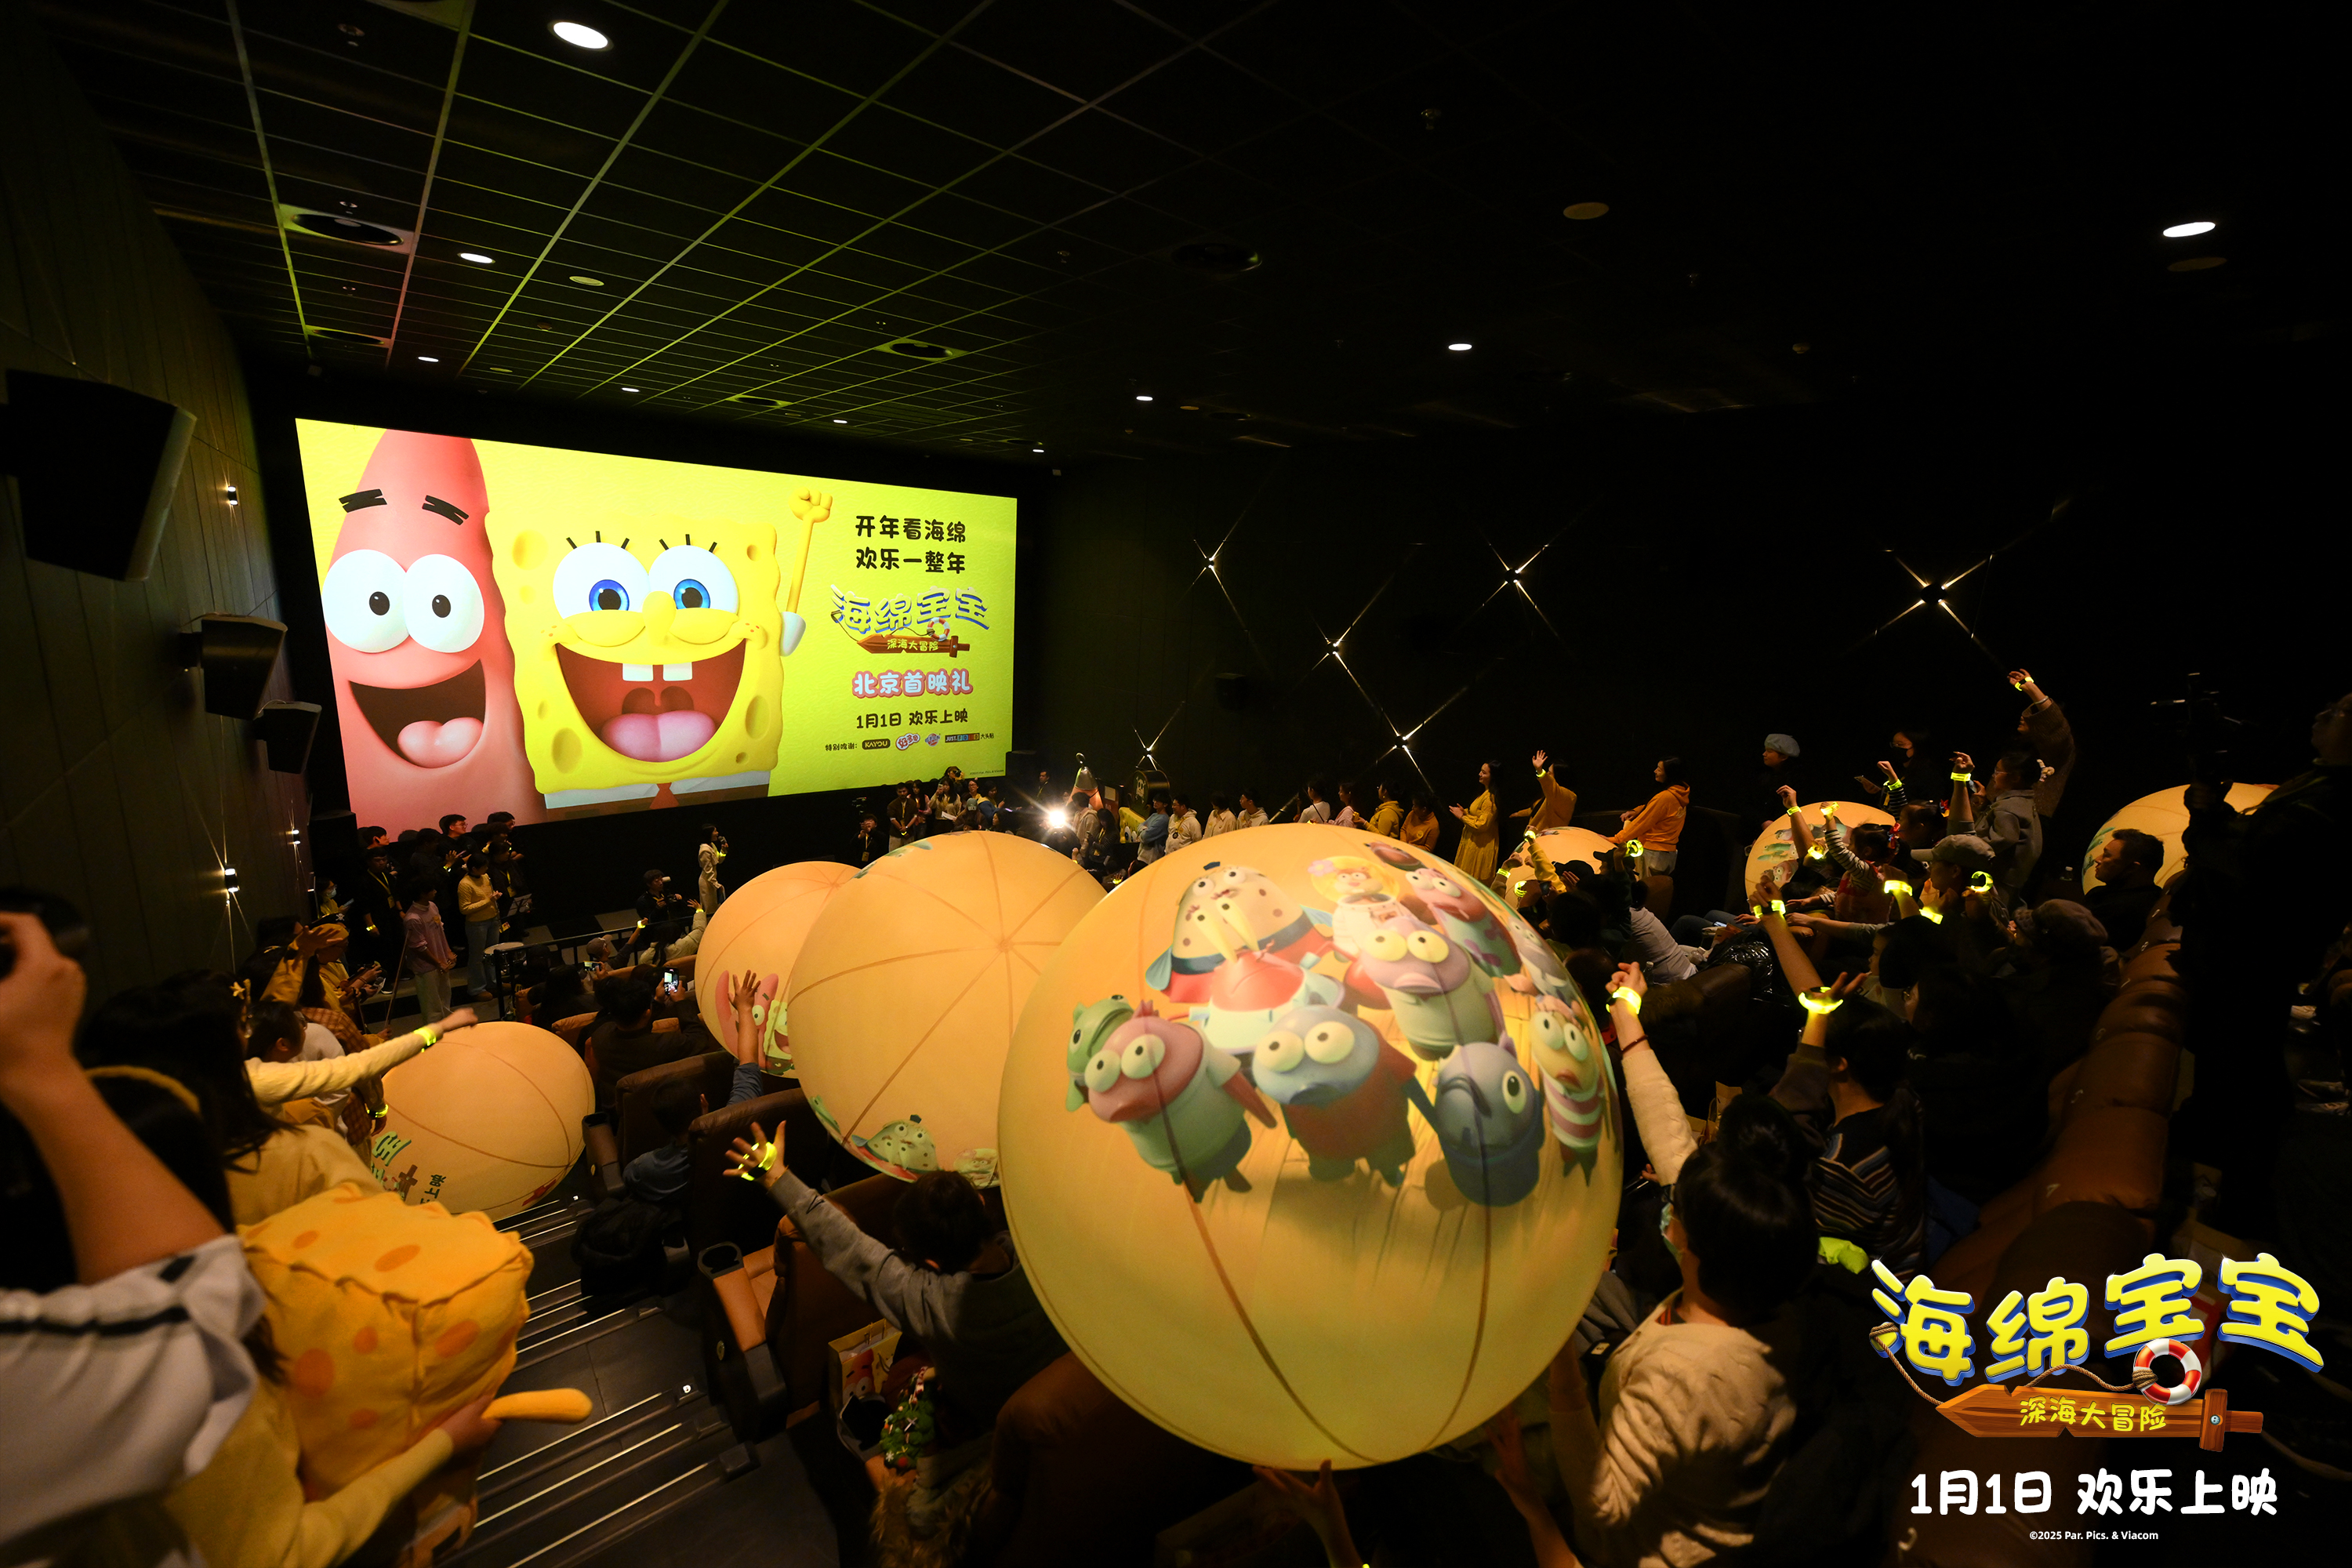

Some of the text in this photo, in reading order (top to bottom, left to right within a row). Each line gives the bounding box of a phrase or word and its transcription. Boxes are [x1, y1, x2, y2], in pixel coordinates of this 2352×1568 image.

[855, 515, 966, 543] 开年看海绵
[856, 546, 966, 574] 欢乐一整年
[830, 584, 990, 634] 海绵宝宝
[887, 638, 939, 652] 深海大冒险
[854, 670, 971, 696] 北京首映礼
[856, 708, 968, 729] 1月1日 欢乐上映
